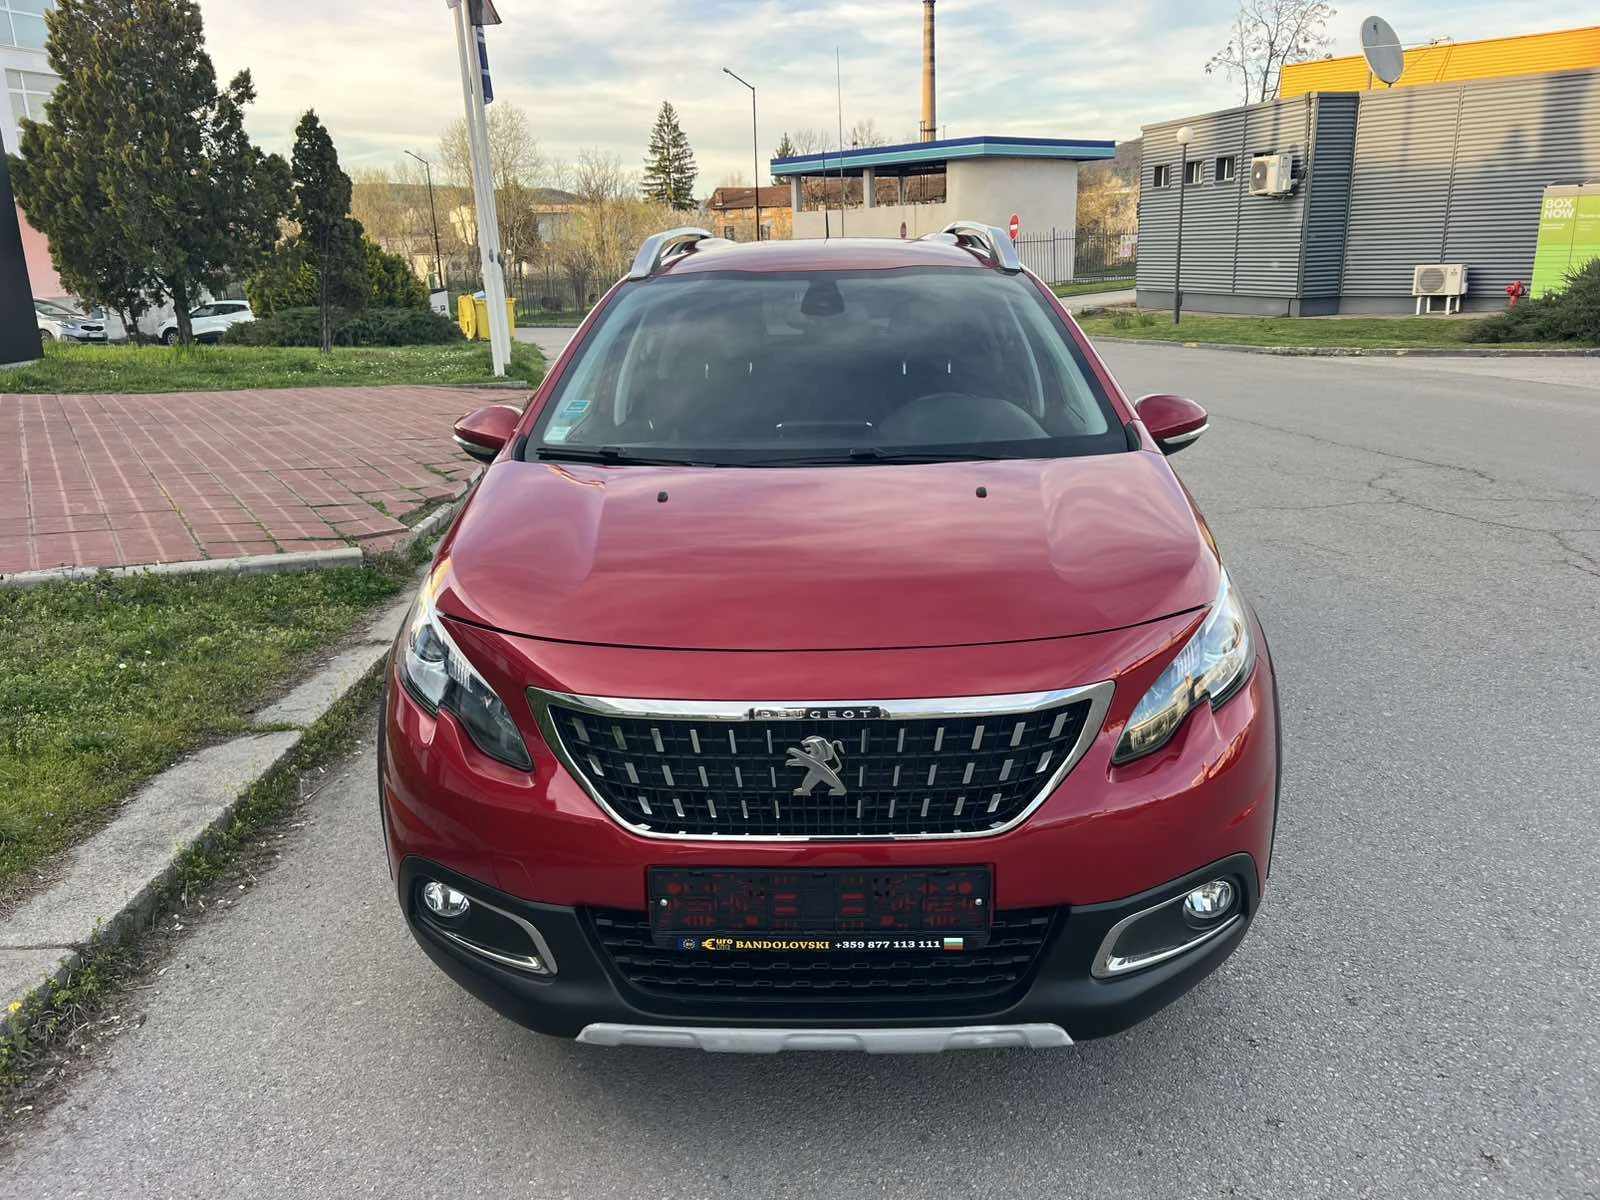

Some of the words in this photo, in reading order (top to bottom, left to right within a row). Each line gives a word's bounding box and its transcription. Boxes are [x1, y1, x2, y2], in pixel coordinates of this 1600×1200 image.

[1545, 199, 1573, 209] BOX
[1543, 208, 1574, 219] NOW
[760, 709, 871, 719] PEUGEOT
[735, 940, 831, 950] BANDOLOVSKI
[835, 940, 865, 949] +359
[867, 940, 890, 949] 877
[893, 940, 915, 949] 113
[918, 940, 941, 948] 111
